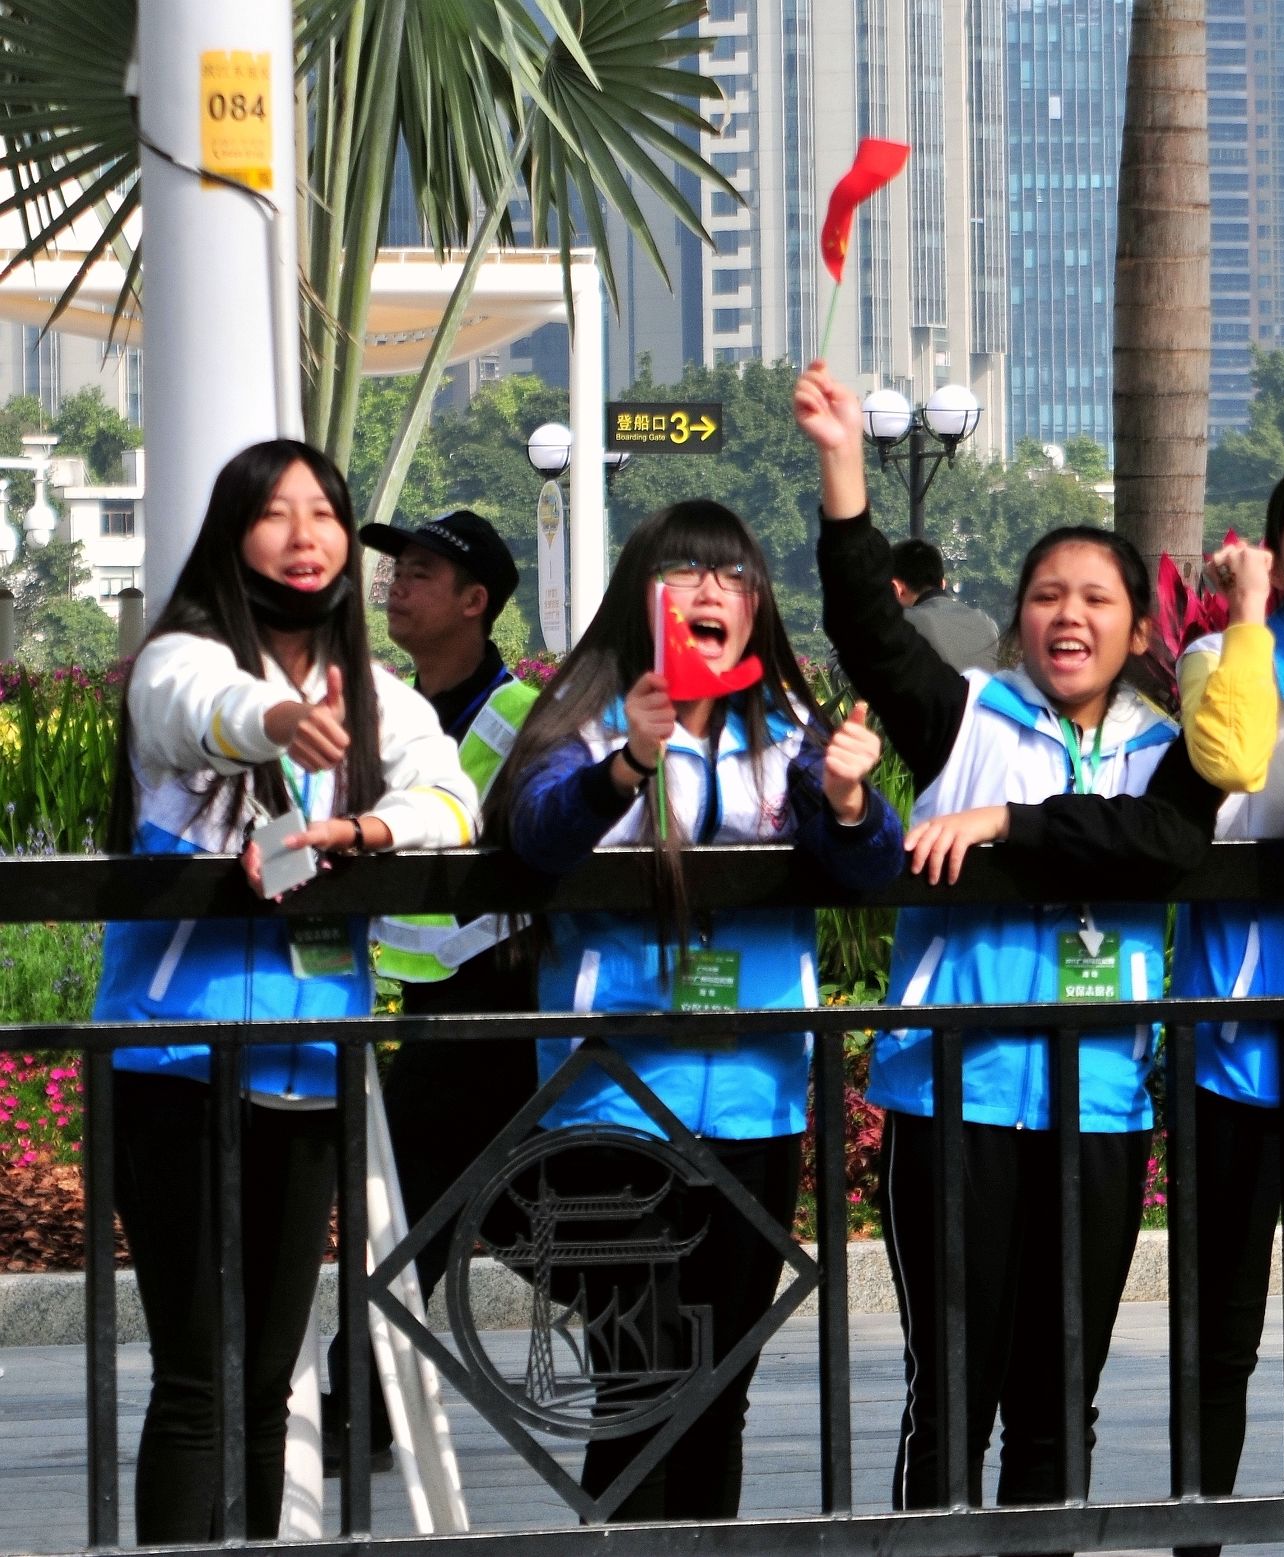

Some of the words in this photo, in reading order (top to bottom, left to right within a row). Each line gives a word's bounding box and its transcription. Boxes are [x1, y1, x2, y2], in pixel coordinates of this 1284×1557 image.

[208, 93, 266, 122] 084
[615, 433, 647, 442] Boarding
[648, 433, 666, 442] Gate
[616, 413, 666, 431] 登船口
[670, 411, 689, 444] 3
